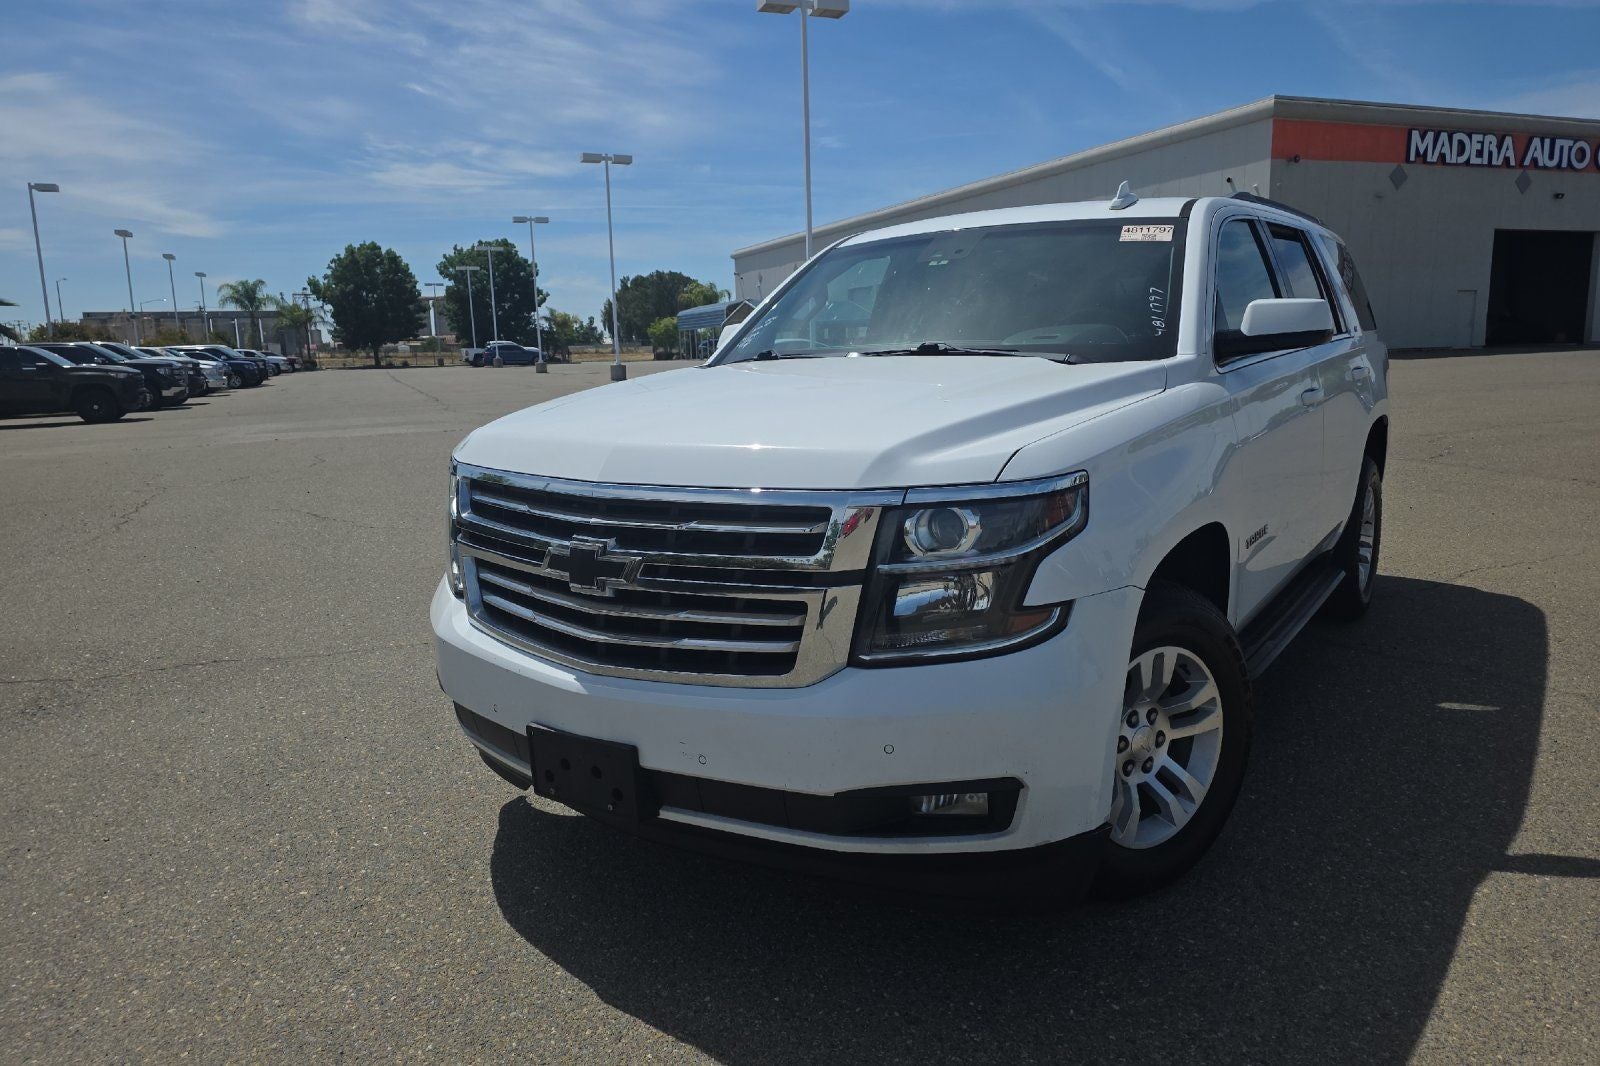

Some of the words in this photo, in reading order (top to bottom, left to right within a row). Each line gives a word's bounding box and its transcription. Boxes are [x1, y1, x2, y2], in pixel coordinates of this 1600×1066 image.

[1408, 130, 1516, 167] MADERA
[1523, 136, 1591, 170] AUTO
[1148, 286, 1166, 337] 4811797
